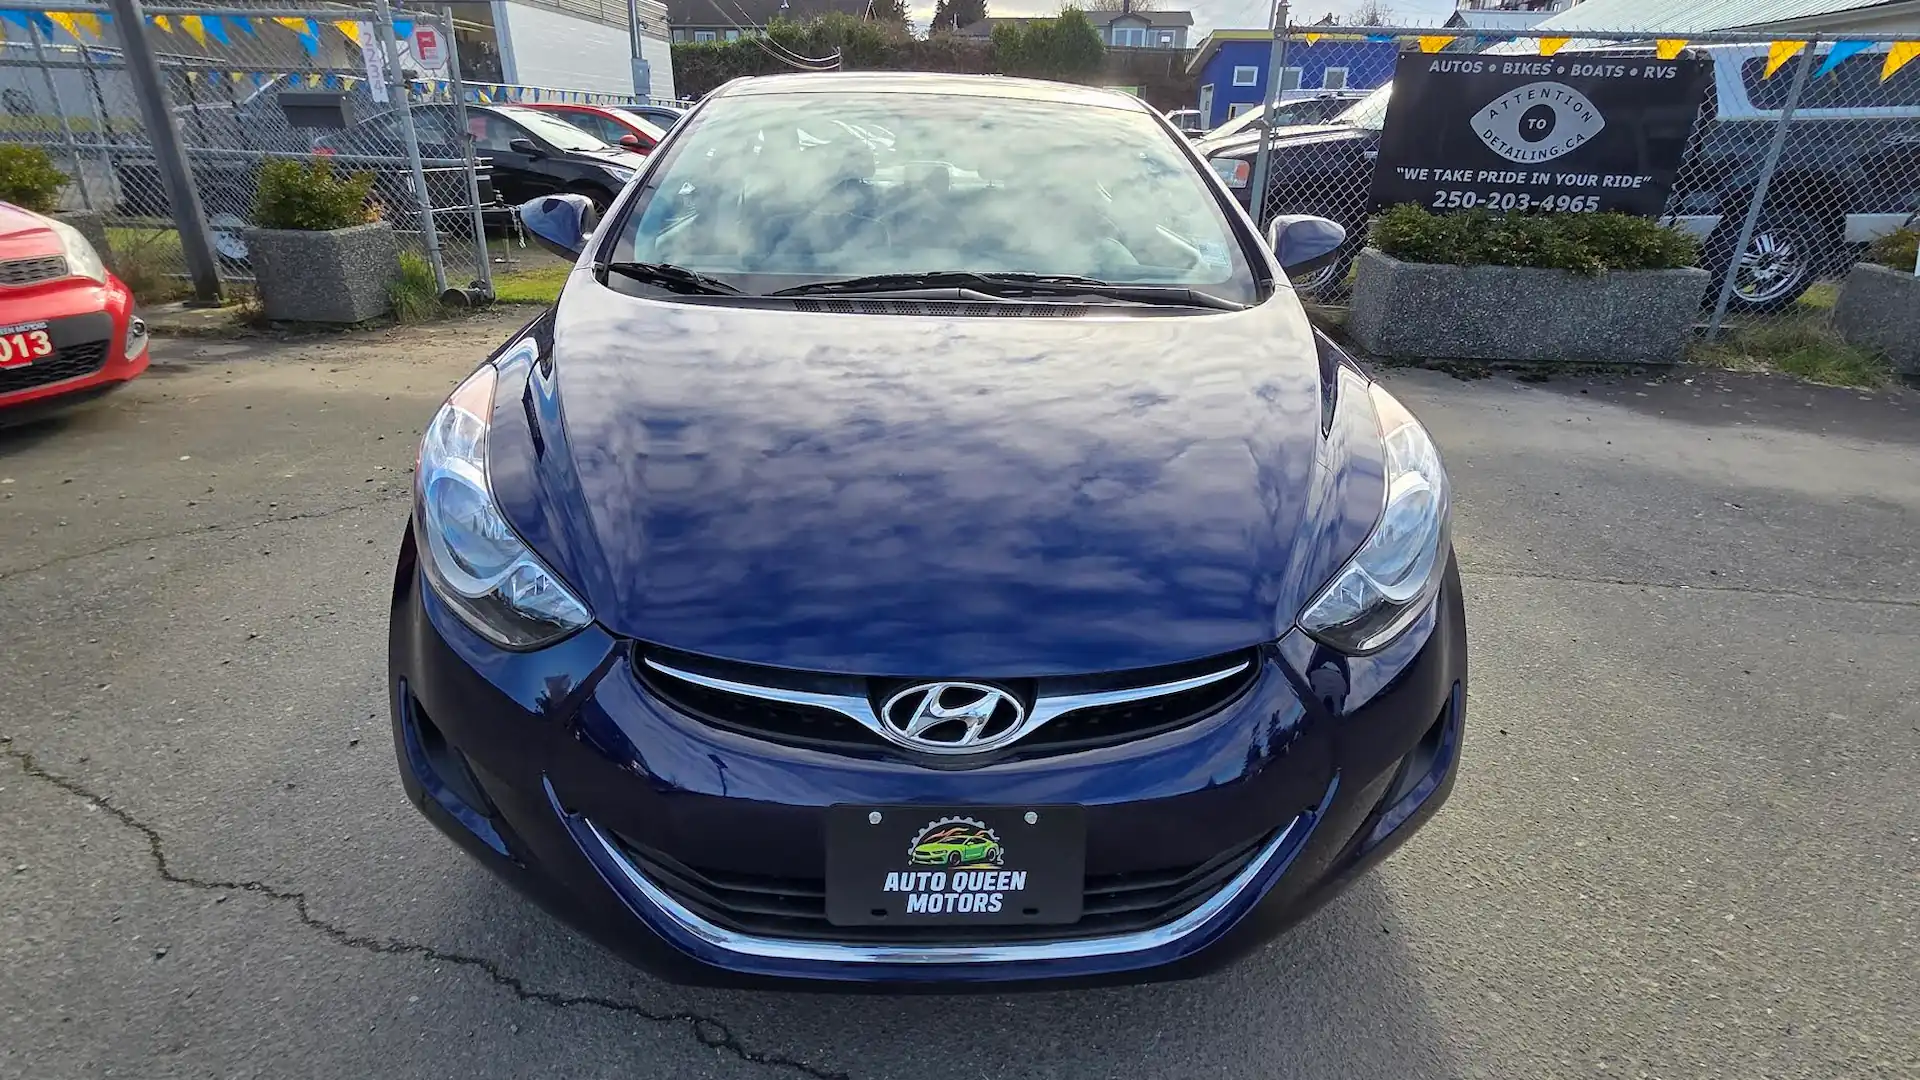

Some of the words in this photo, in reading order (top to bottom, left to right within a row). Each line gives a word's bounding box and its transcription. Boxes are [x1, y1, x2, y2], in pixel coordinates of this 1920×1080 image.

[363, 32, 384, 93] 2234
[1429, 60, 1483, 73] AUTOS
[1502, 62, 1551, 75] BIKES
[1571, 64, 1625, 77] BOATS
[1643, 66, 1677, 79] RVS
[1488, 88, 1593, 123] ATTENTION
[1527, 118, 1547, 130] TO
[1482, 129, 1586, 160] DETAILING.CA
[1433, 168, 1473, 182] TAKE
[1477, 171, 1526, 184] PRIDE
[1530, 172, 1550, 185] IN
[1556, 173, 1598, 187] YOUR
[1432, 190, 1601, 212] 250-203-4965
[883, 872, 947, 892] AUTO
[951, 871, 1027, 893] QUEEN
[906, 893, 1003, 914] MOTORS
